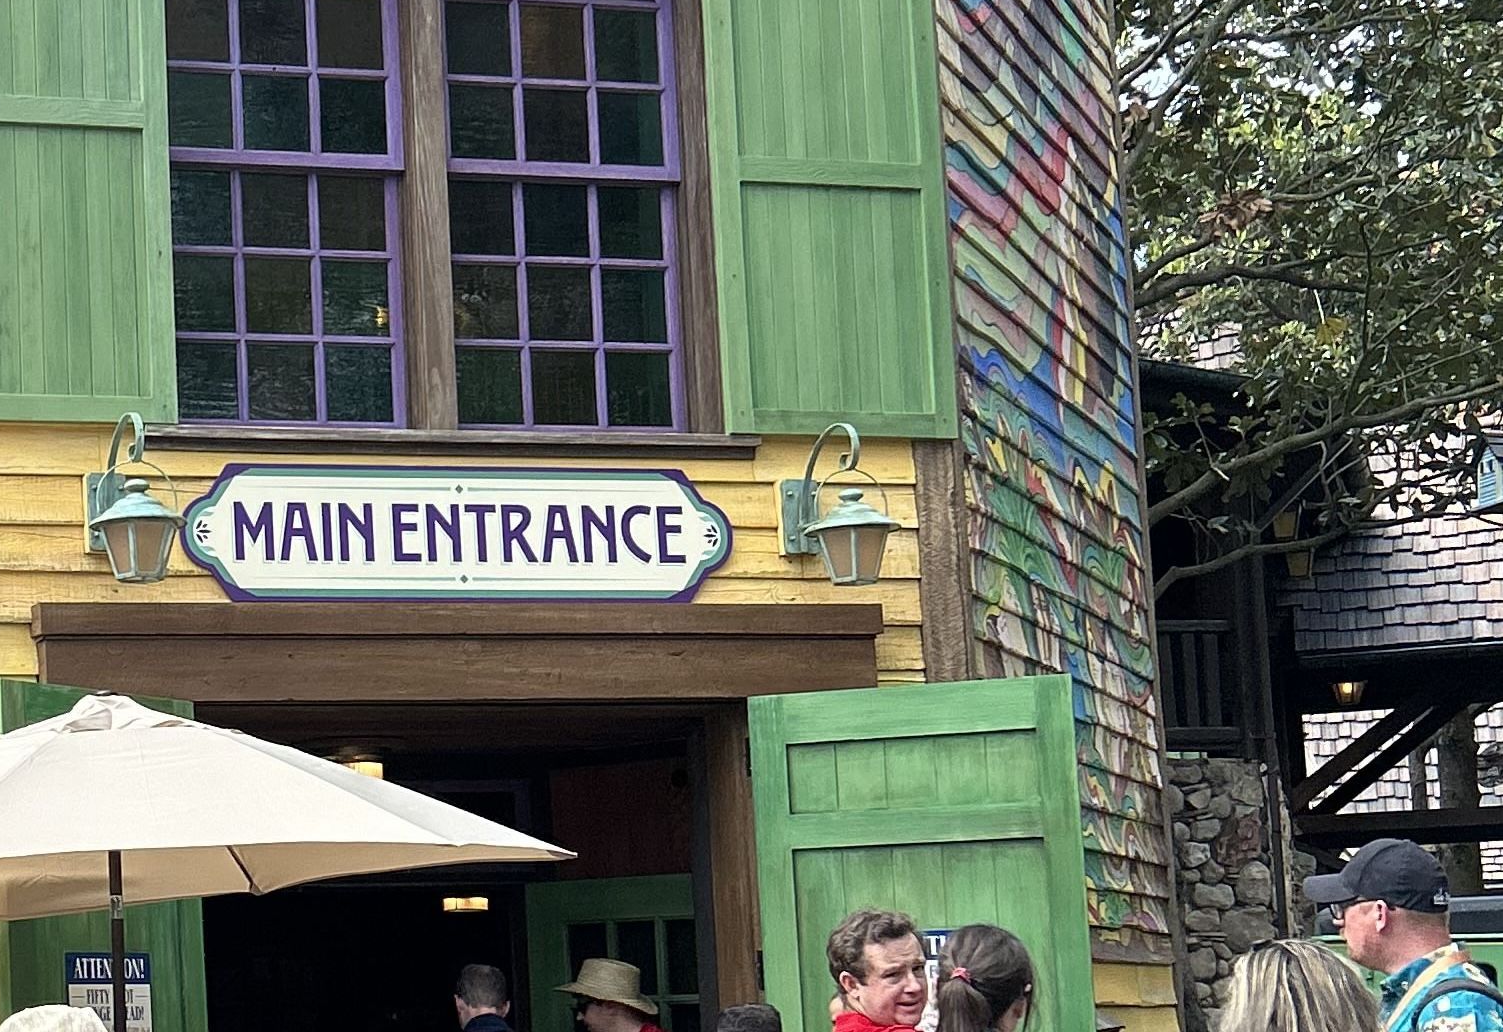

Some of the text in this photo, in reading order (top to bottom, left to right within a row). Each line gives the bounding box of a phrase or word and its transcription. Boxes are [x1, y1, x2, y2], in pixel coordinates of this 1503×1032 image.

[233, 501, 687, 565] MAIN ENTRANCE
[73, 957, 145, 979] ATTENON!
[87, 989, 110, 1004] FIFTY
